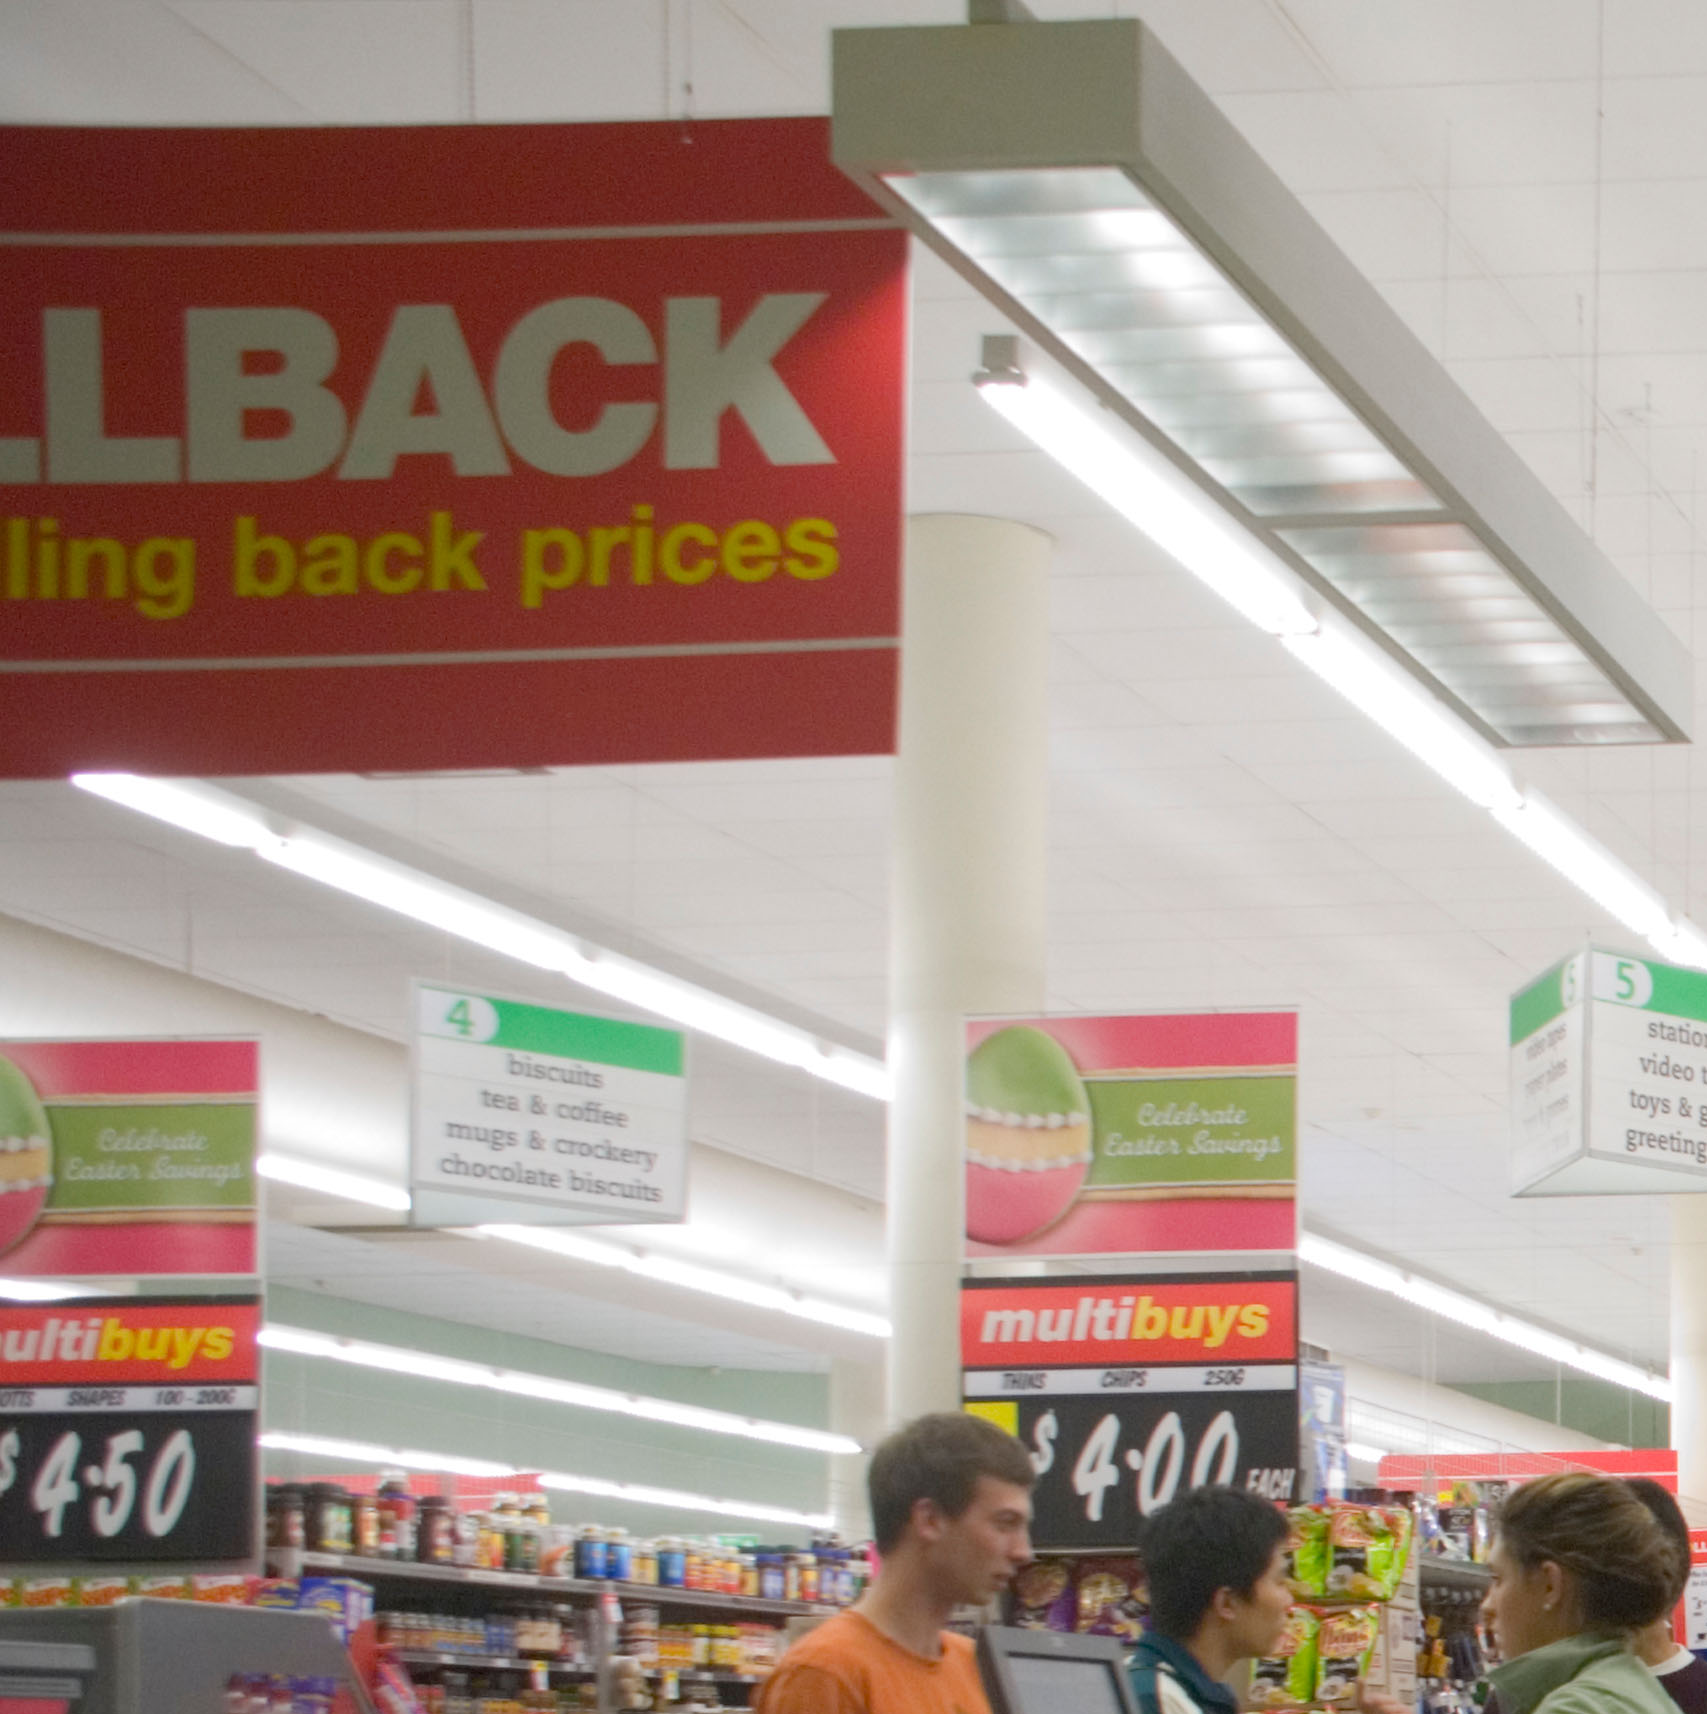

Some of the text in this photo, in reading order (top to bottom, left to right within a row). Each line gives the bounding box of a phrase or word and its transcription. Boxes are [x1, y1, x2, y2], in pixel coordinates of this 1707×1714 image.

[234, 511, 489, 598] back
[521, 505, 840, 609] prices
[1616, 962, 1635, 999] 5
[446, 999, 475, 1036] 4
[507, 1053, 604, 1088] biscuits
[1639, 1054, 1694, 1081] video
[480, 1089, 628, 1128] tea & coffee
[1137, 1103, 1247, 1128] Celebrate
[1630, 1090, 1670, 1118] toys
[1679, 1097, 1692, 1117] &
[96, 1129, 208, 1151] Celebrate
[445, 1122, 659, 1172] mugs & crockery
[1105, 1131, 1283, 1160] Easter Savings
[1625, 1129, 1707, 1163] greeting
[65, 1156, 243, 1186] Easter Savings
[440, 1153, 663, 1202] chocolate biscuits
[980, 1296, 1270, 1347] multibuys
[0, 1318, 234, 1369] ultibuys
[1002, 1369, 1245, 1389] THINS CHIPS 250G
[67, 1389, 126, 1406] SHAPES
[1247, 1468, 1294, 1499] EACH
